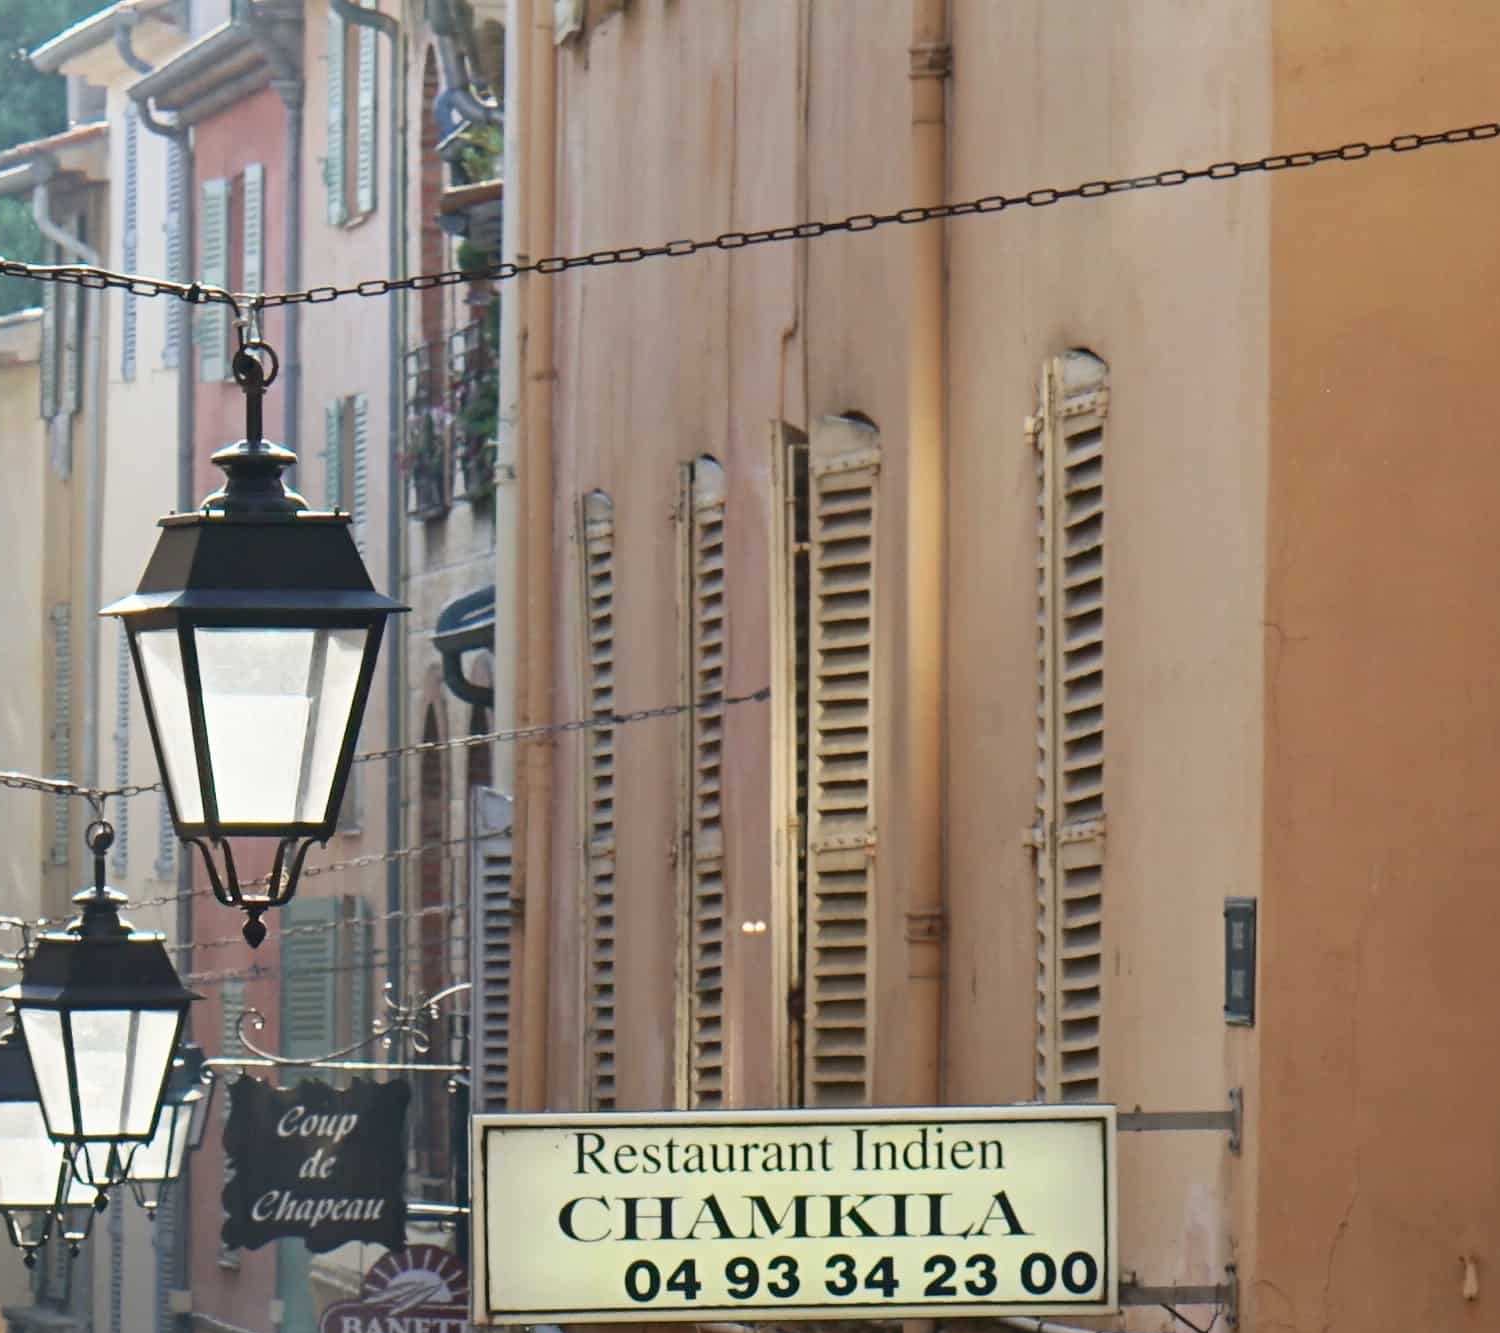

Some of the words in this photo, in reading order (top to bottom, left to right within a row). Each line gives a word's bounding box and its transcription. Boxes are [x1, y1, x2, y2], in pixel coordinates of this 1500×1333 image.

[277, 1105, 359, 1143] Coup
[298, 1152, 338, 1179] de
[573, 1130, 833, 1175] Restaurant
[851, 1127, 1007, 1172] Indien
[252, 1190, 385, 1228] Chapeau
[557, 1190, 1036, 1243] CHAMKILA
[624, 1258, 702, 1303] 04
[725, 1256, 801, 1300] 93
[824, 1254, 900, 1299] 34
[922, 1252, 998, 1297] 23
[1020, 1250, 1099, 1295] 00
